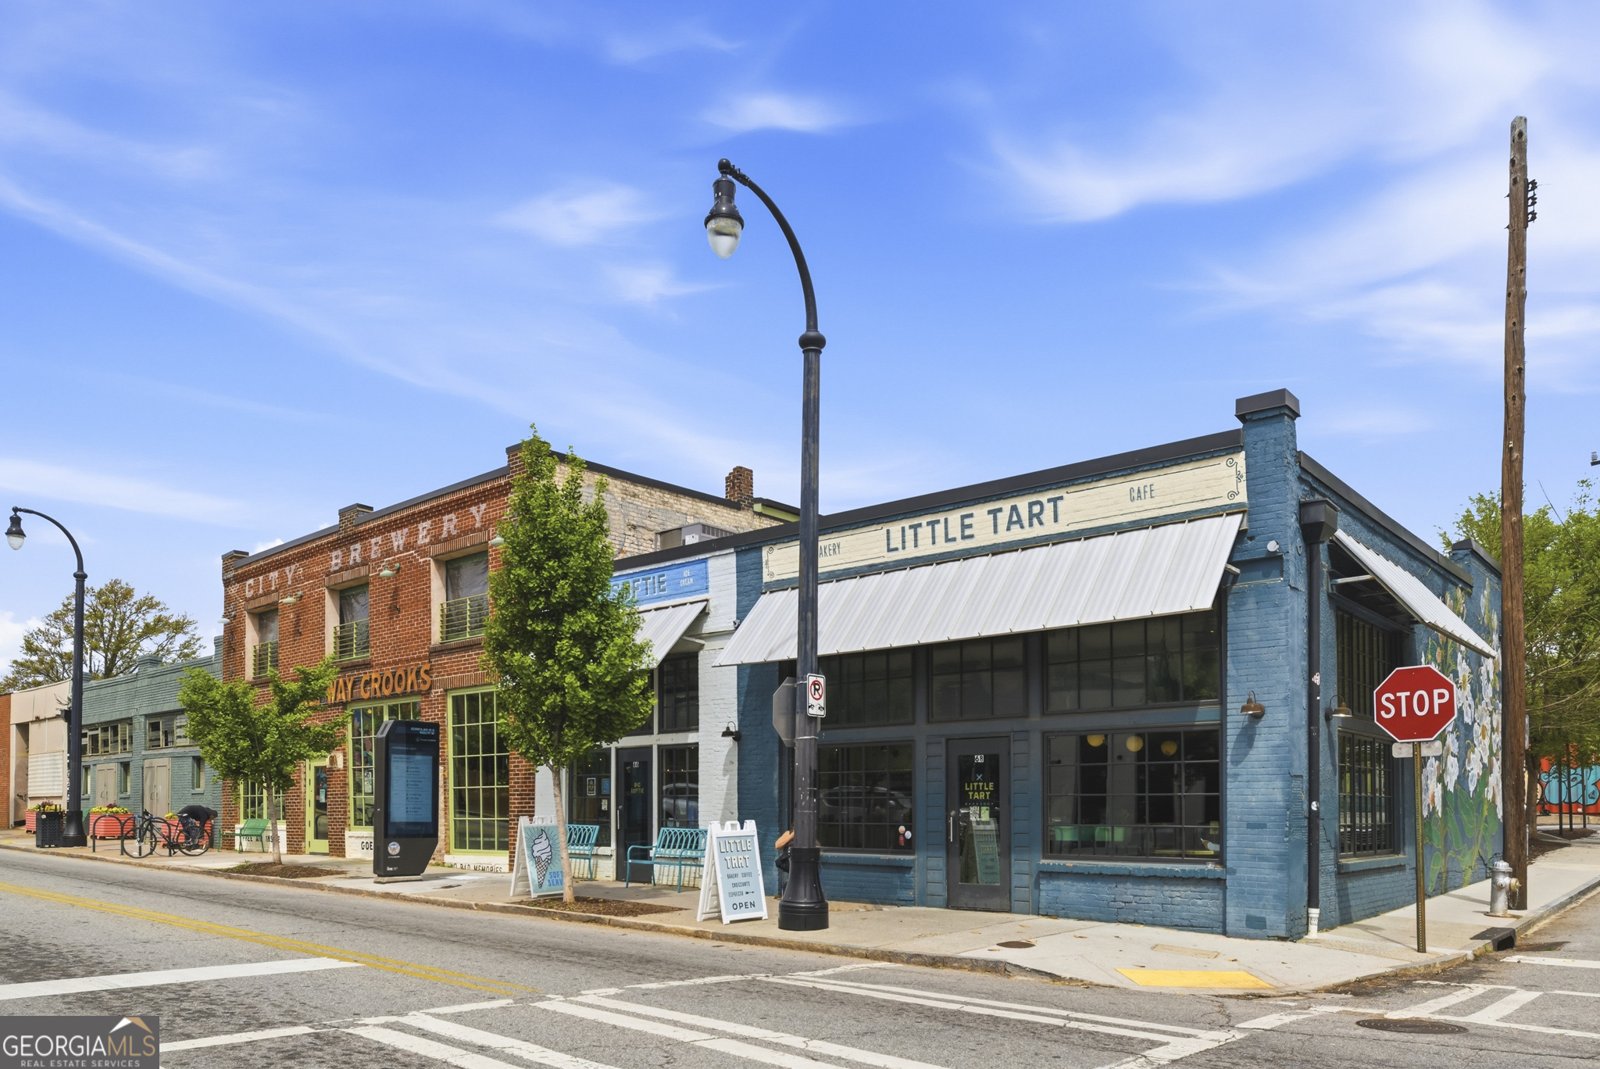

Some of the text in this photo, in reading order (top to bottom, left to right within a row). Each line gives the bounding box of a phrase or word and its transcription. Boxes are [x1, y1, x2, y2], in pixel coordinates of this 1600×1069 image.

[1128, 484, 1155, 503] CAFE
[885, 495, 1064, 553] LITTLE TART
[245, 503, 487, 599] CITY BREWERY
[818, 541, 841, 559] AKERY
[360, 662, 432, 699] CROOKS
[1380, 688, 1450, 719] STOP
[964, 782, 995, 791] LITTLE
[968, 791, 991, 800] TART
[361, 841, 374, 851] GOE
[720, 839, 752, 853] LITTLE
[732, 901, 756, 911] OPEN
